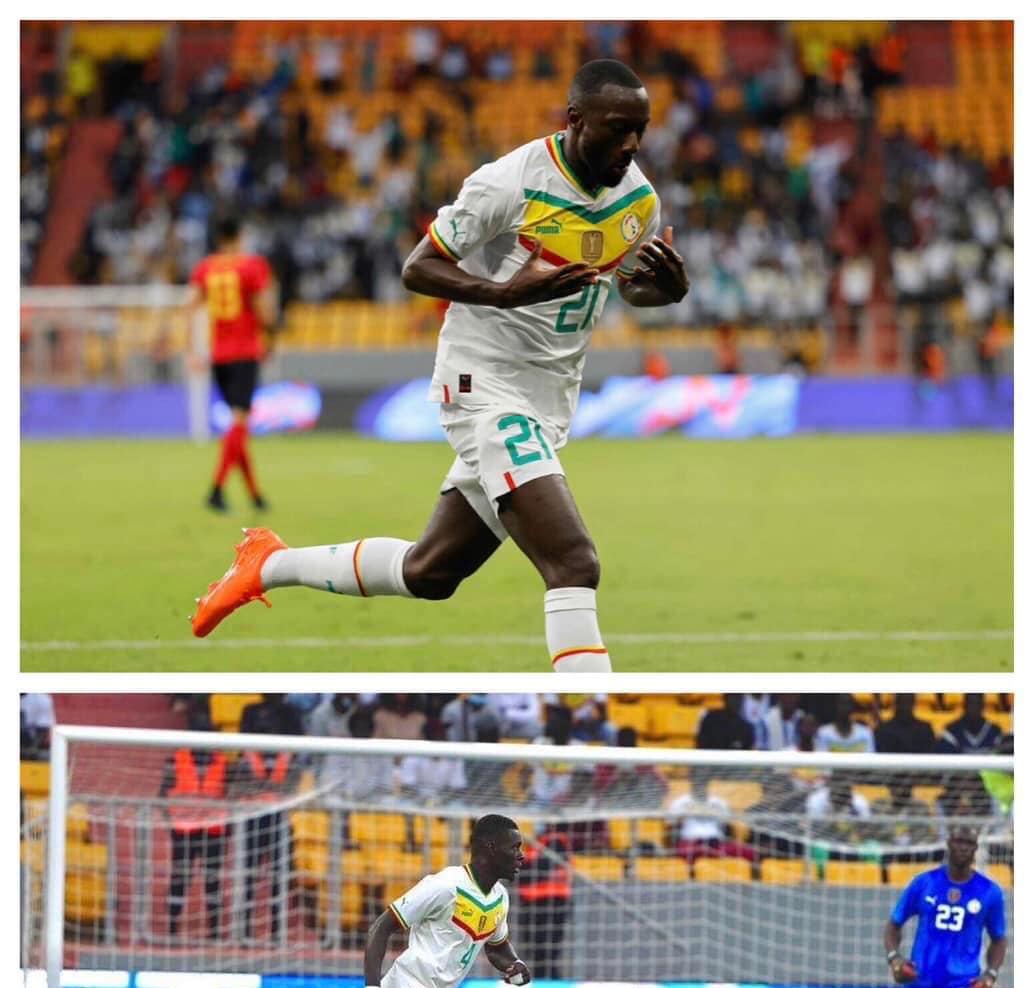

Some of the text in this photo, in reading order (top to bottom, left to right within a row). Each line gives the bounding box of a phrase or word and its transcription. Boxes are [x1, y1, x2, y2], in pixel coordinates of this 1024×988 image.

[497, 414, 553, 467] 21
[934, 903, 966, 932] 23
[460, 943, 477, 969] 4
